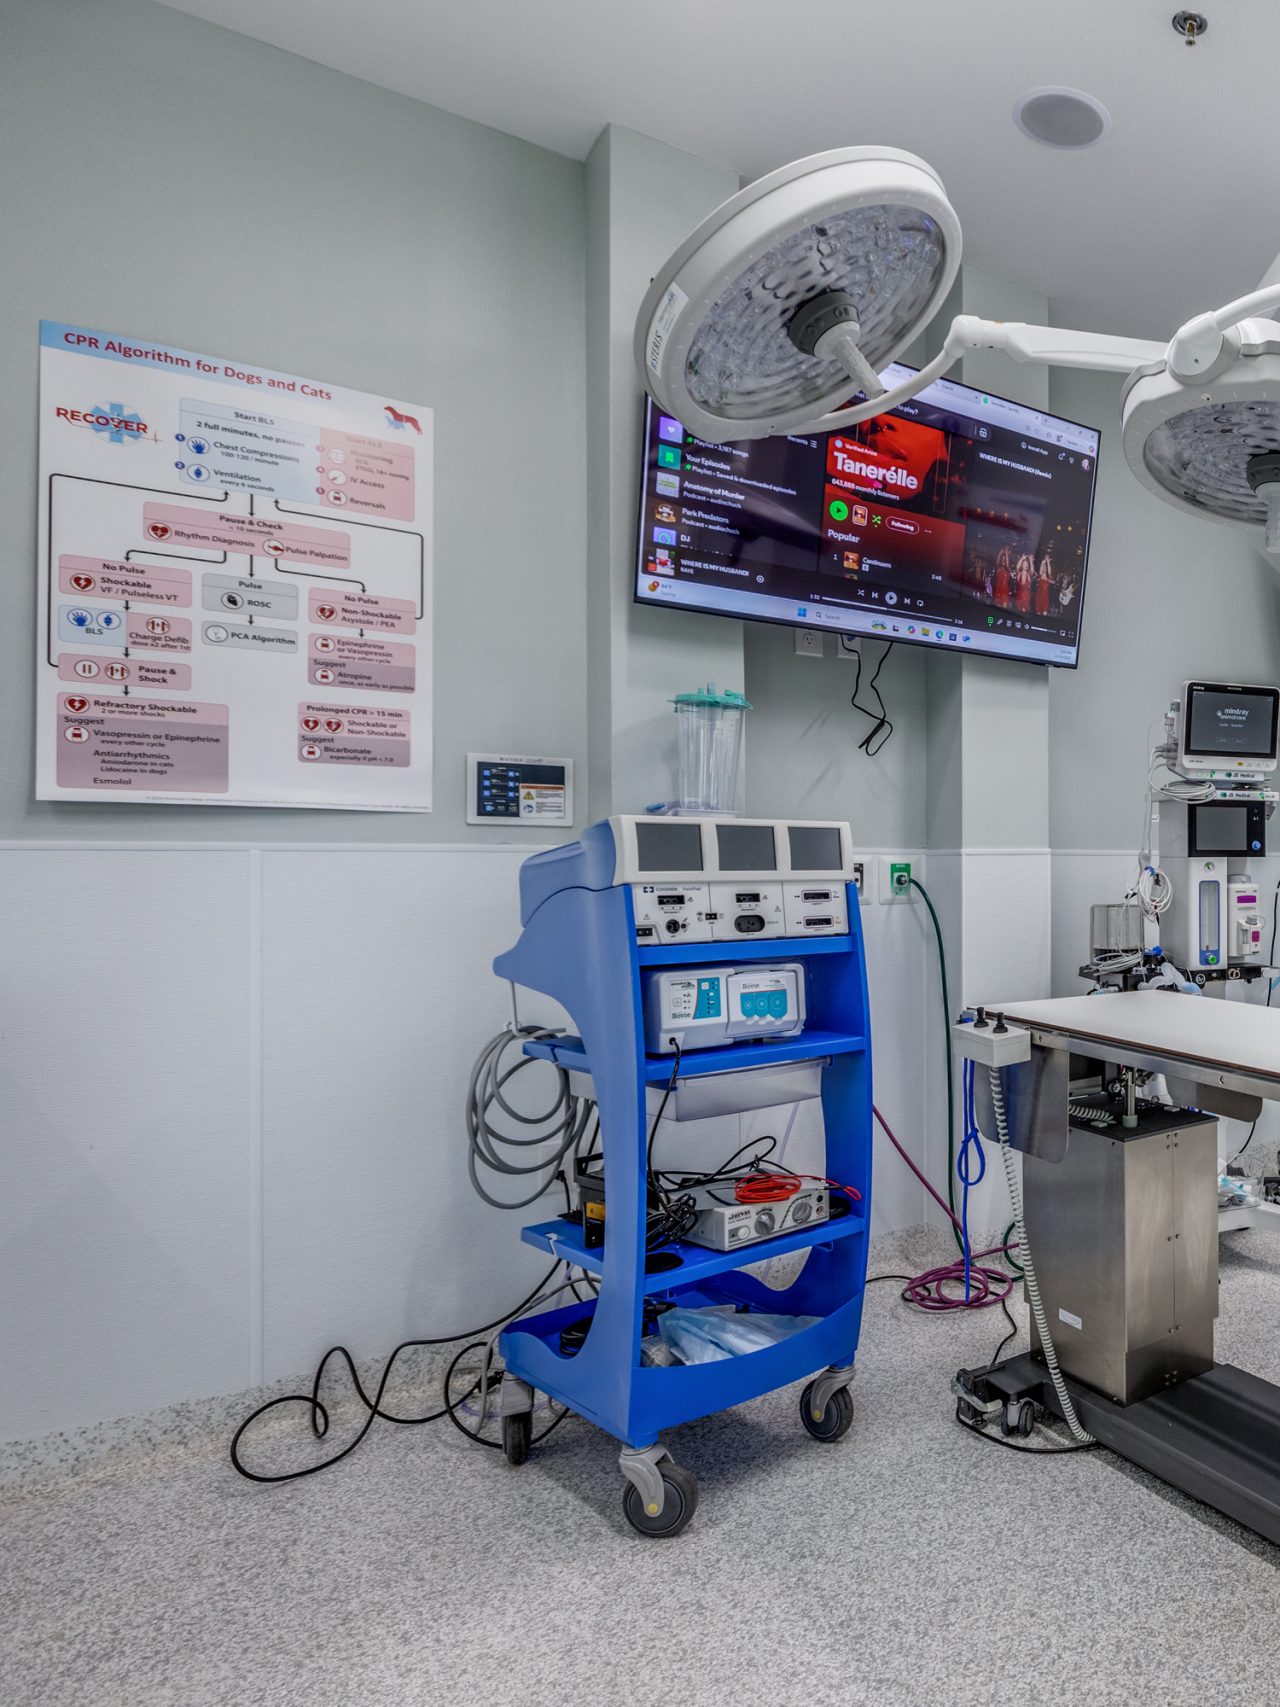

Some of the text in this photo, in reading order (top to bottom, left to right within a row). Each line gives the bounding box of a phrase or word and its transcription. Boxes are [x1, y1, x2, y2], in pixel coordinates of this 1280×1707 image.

[64, 332, 332, 400] CPR Algorithm for Dogs and Cats
[56, 407, 148, 433] RECOVER
[234, 411, 257, 422] Start
[204, 422, 220, 431] full
[214, 441, 299, 463] Chest Compressions
[685, 454, 730, 470] Your Episodes
[833, 451, 918, 489] Tanerélle
[213, 469, 261, 483] Ventilation
[683, 481, 715, 495] Anatomy
[721, 489, 745, 500] Murder
[219, 515, 246, 525] Pause
[256, 520, 283, 531] Check
[174, 530, 255, 548] Rhythm Diagnosis
[828, 529, 860, 543] Popular
[285, 546, 348, 562] Pulse Palpation
[103, 563, 146, 575] No Pulse
[100, 576, 152, 589] Shockable
[238, 581, 262, 590] Pulse
[100, 586, 113, 594] VF
[121, 589, 164, 600] Pulseless
[247, 599, 272, 608] ROSC
[357, 596, 379, 605] Pulse
[341, 607, 402, 621] Non-Shockable
[341, 616, 375, 626] Asystole
[85, 627, 104, 635] BLS
[129, 632, 189, 644] Charge Defib
[231, 632, 296, 645] PCA Algorithm
[337, 639, 385, 651] Epinephrine
[347, 647, 393, 659] Vasopressin
[313, 659, 346, 669] Suggest
[138, 665, 167, 675] Pause
[138, 675, 168, 683] Shock
[337, 672, 372, 681] Atropine
[94, 700, 198, 714] Refractory Shockable
[306, 705, 350, 714] Prolonged
[1224, 707, 1249, 717] mindray
[64, 716, 105, 726] Suggest
[347, 719, 387, 729] Shockable
[93, 730, 151, 741] Vasopressin
[165, 731, 220, 745] Epinephrine
[347, 729, 406, 738] Non-Shockable
[301, 735, 335, 744] Suggest
[93, 750, 170, 760] Antiarrhythmics
[323, 746, 371, 755] Bicarbonate
[93, 777, 132, 785] Esmolol
[672, 1012, 691, 1020] Bovie
